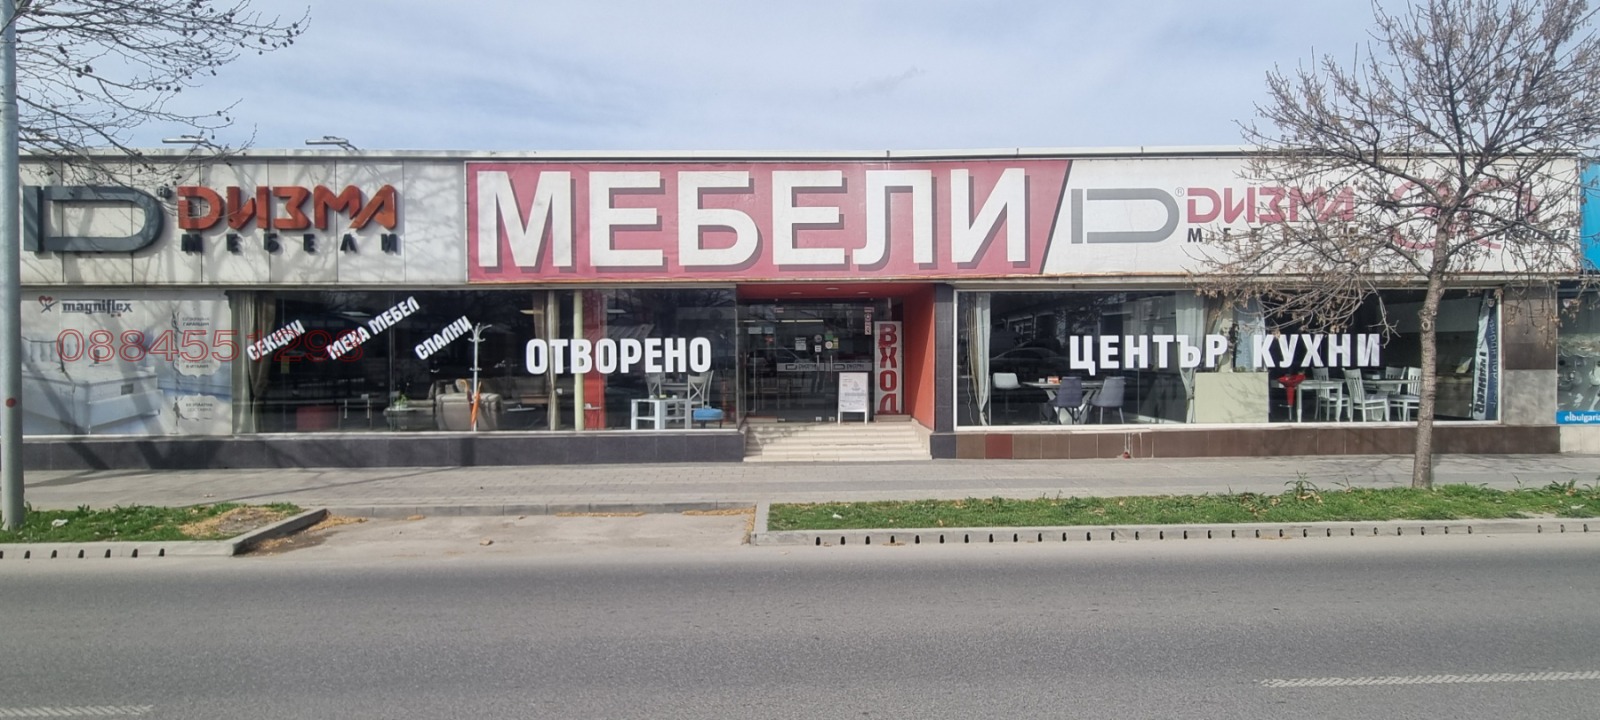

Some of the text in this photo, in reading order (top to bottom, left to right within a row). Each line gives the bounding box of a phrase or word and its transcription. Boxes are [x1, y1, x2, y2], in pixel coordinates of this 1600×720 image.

[177, 185, 397, 230] ДИЗМА
[476, 168, 1030, 271] МЕБЕЛИ
[181, 233, 400, 254] МЕБЕЛИ
[62, 299, 132, 314] magniflex
[327, 296, 421, 361] МЕКА МЕБЕЛ
[246, 319, 306, 361] СЕКЦИИ
[414, 315, 472, 360] СПАЛНИ
[525, 337, 711, 374] ОТВОРЕНО
[1069, 333, 1381, 376] ЦЕНТЪР КУХНИ
[879, 324, 898, 414] ВХОД
